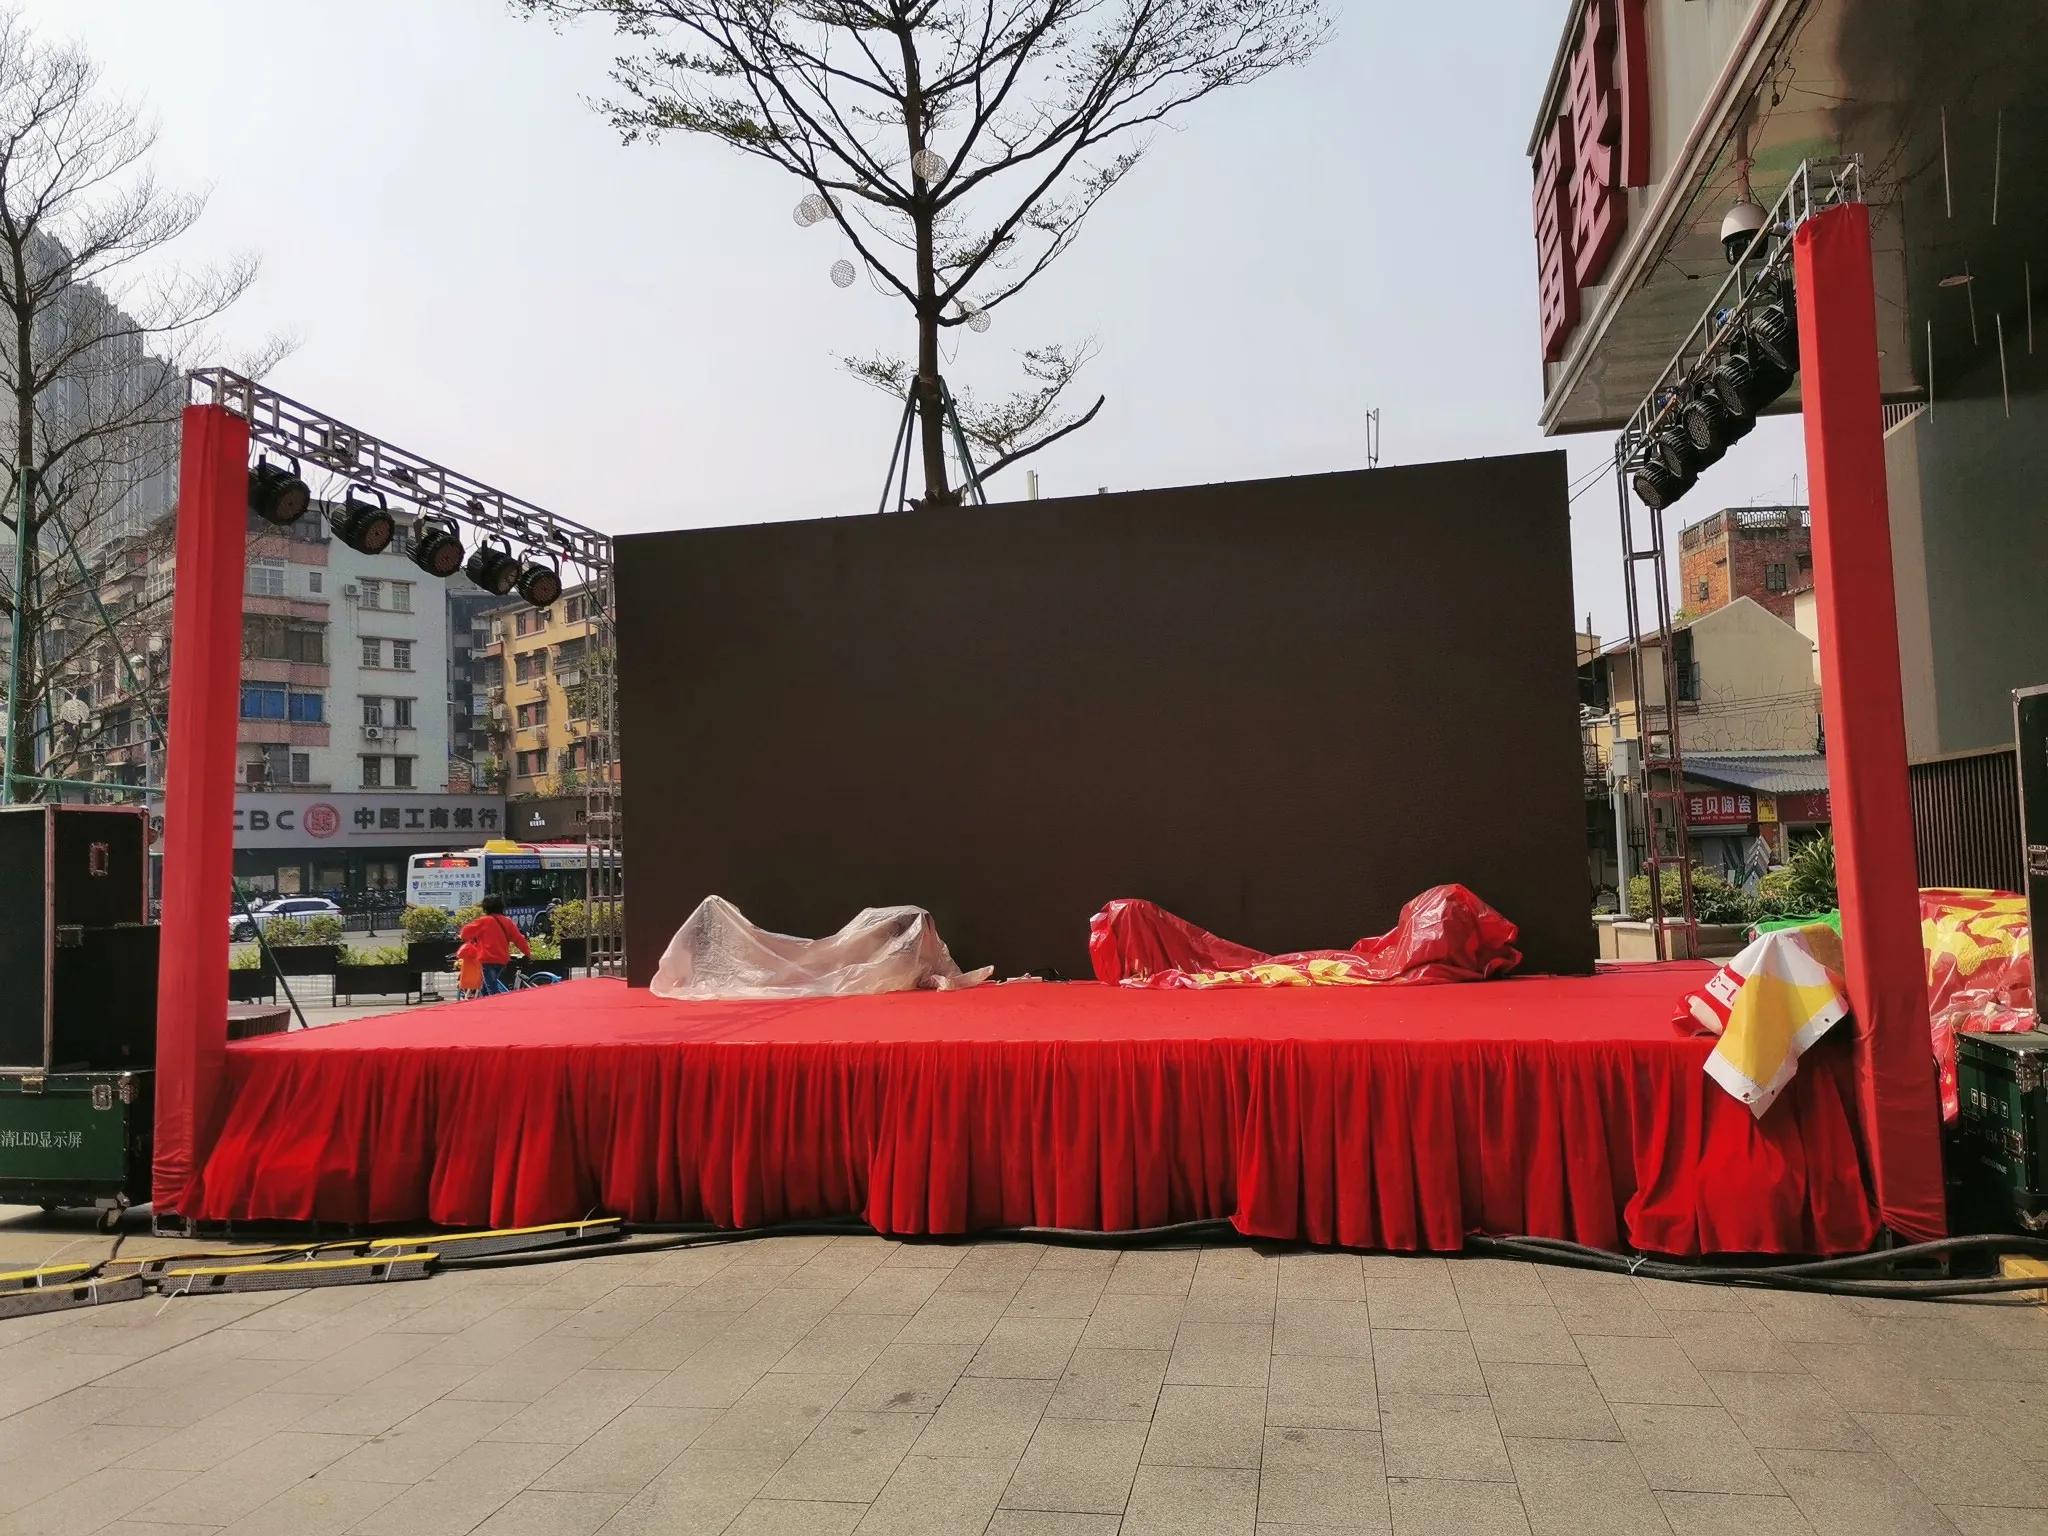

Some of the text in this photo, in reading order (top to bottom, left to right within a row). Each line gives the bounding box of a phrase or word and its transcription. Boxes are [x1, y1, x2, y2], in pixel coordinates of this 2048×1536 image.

[1690, 795, 1752, 815] 宝贝陶瓷
[353, 806, 498, 830] 中国工商银行
